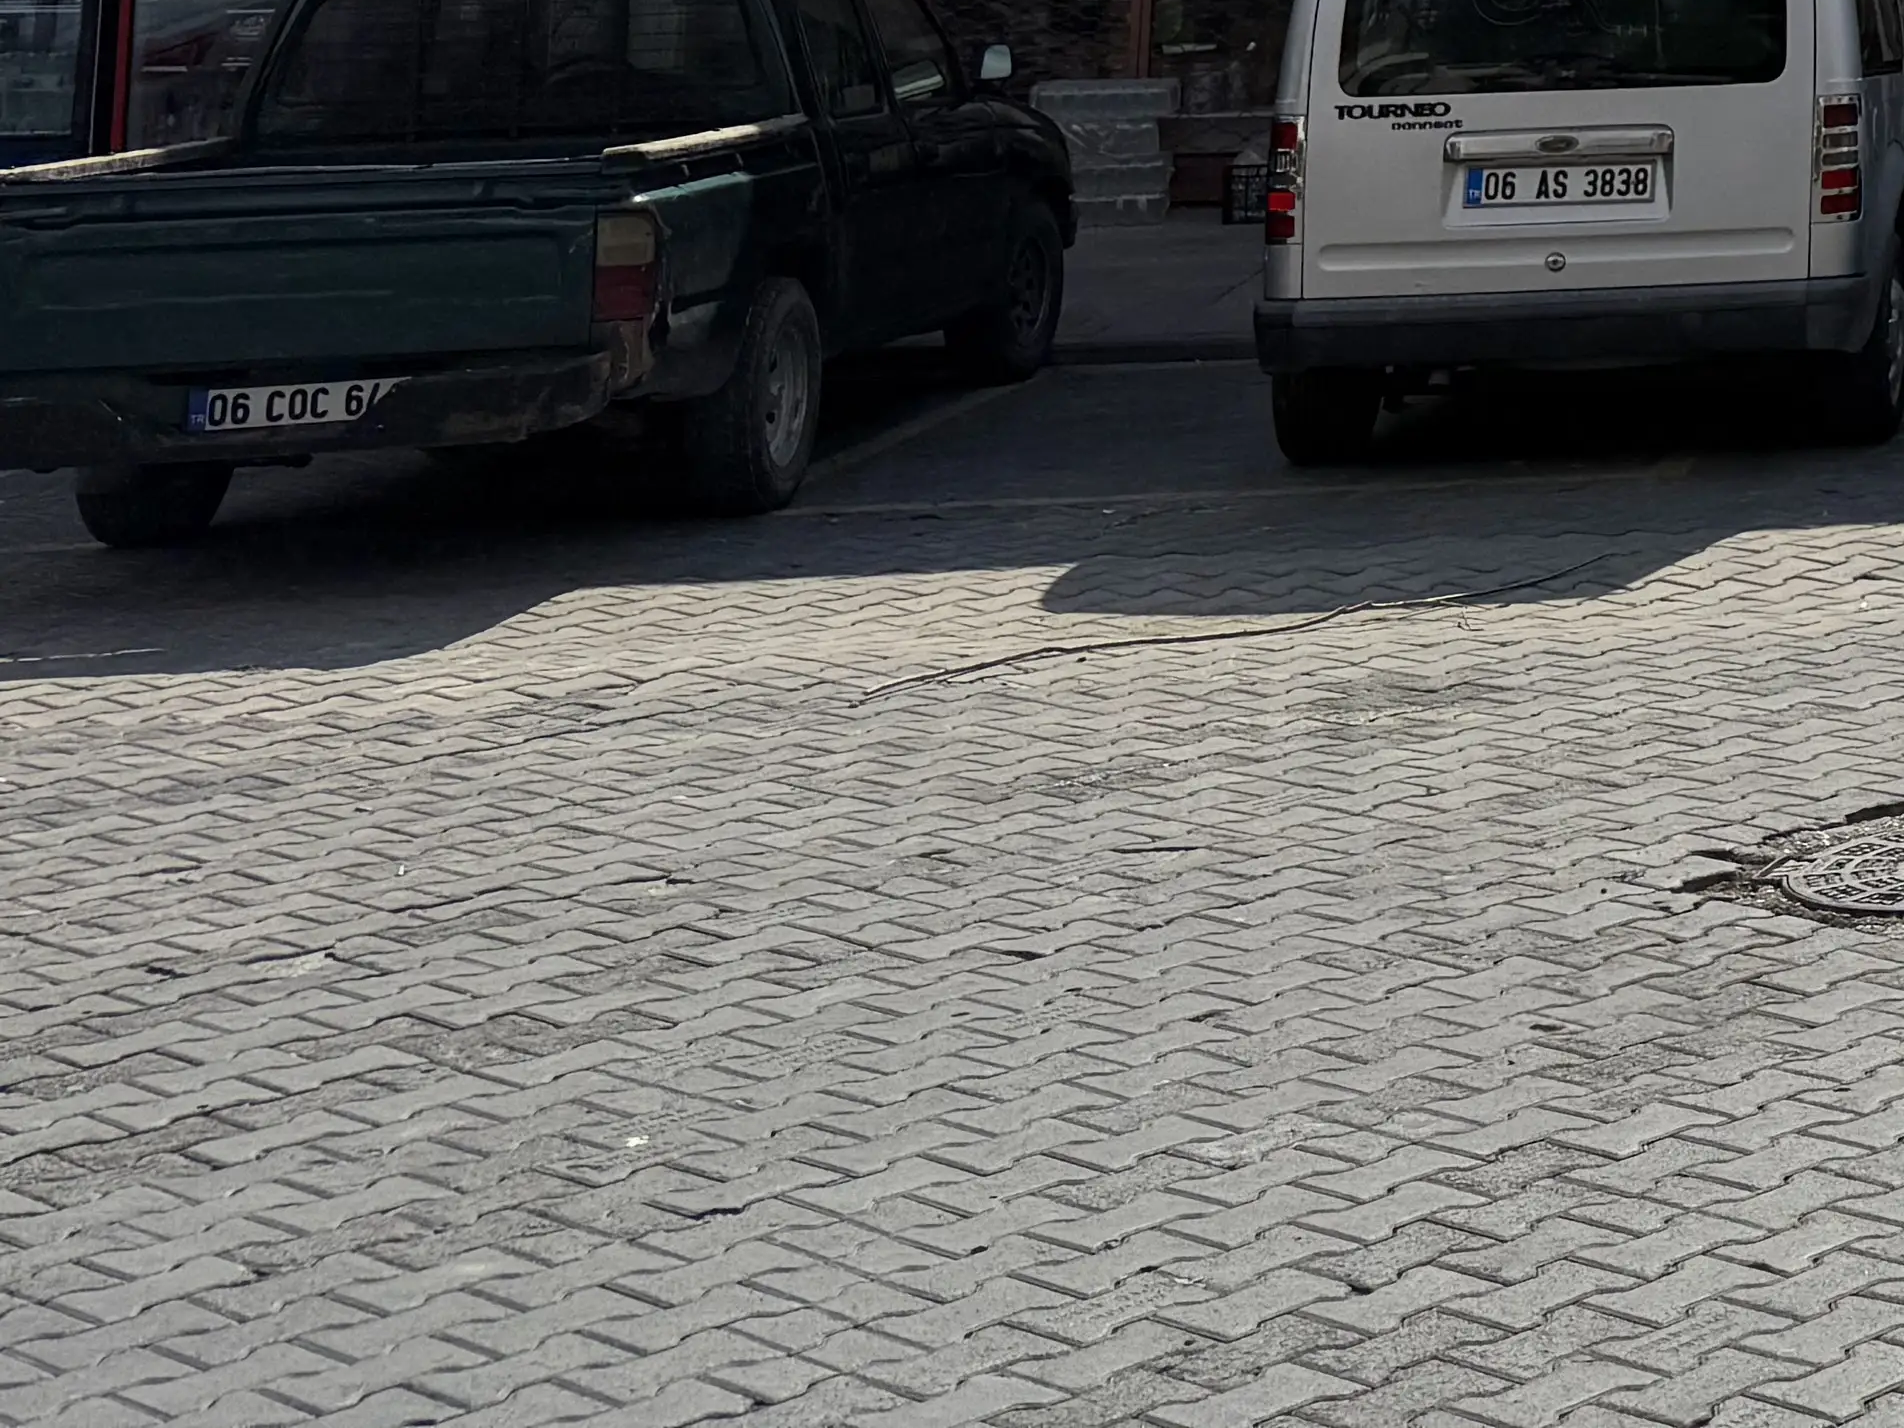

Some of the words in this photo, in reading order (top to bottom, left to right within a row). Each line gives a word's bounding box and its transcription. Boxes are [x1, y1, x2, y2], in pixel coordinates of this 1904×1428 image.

[1335, 102, 1451, 121] TOURNEO
[1484, 171, 1516, 201] 06
[1535, 169, 1569, 201] AS
[1583, 167, 1650, 199] 3838
[208, 392, 251, 428] 06
[266, 387, 329, 422] COC
